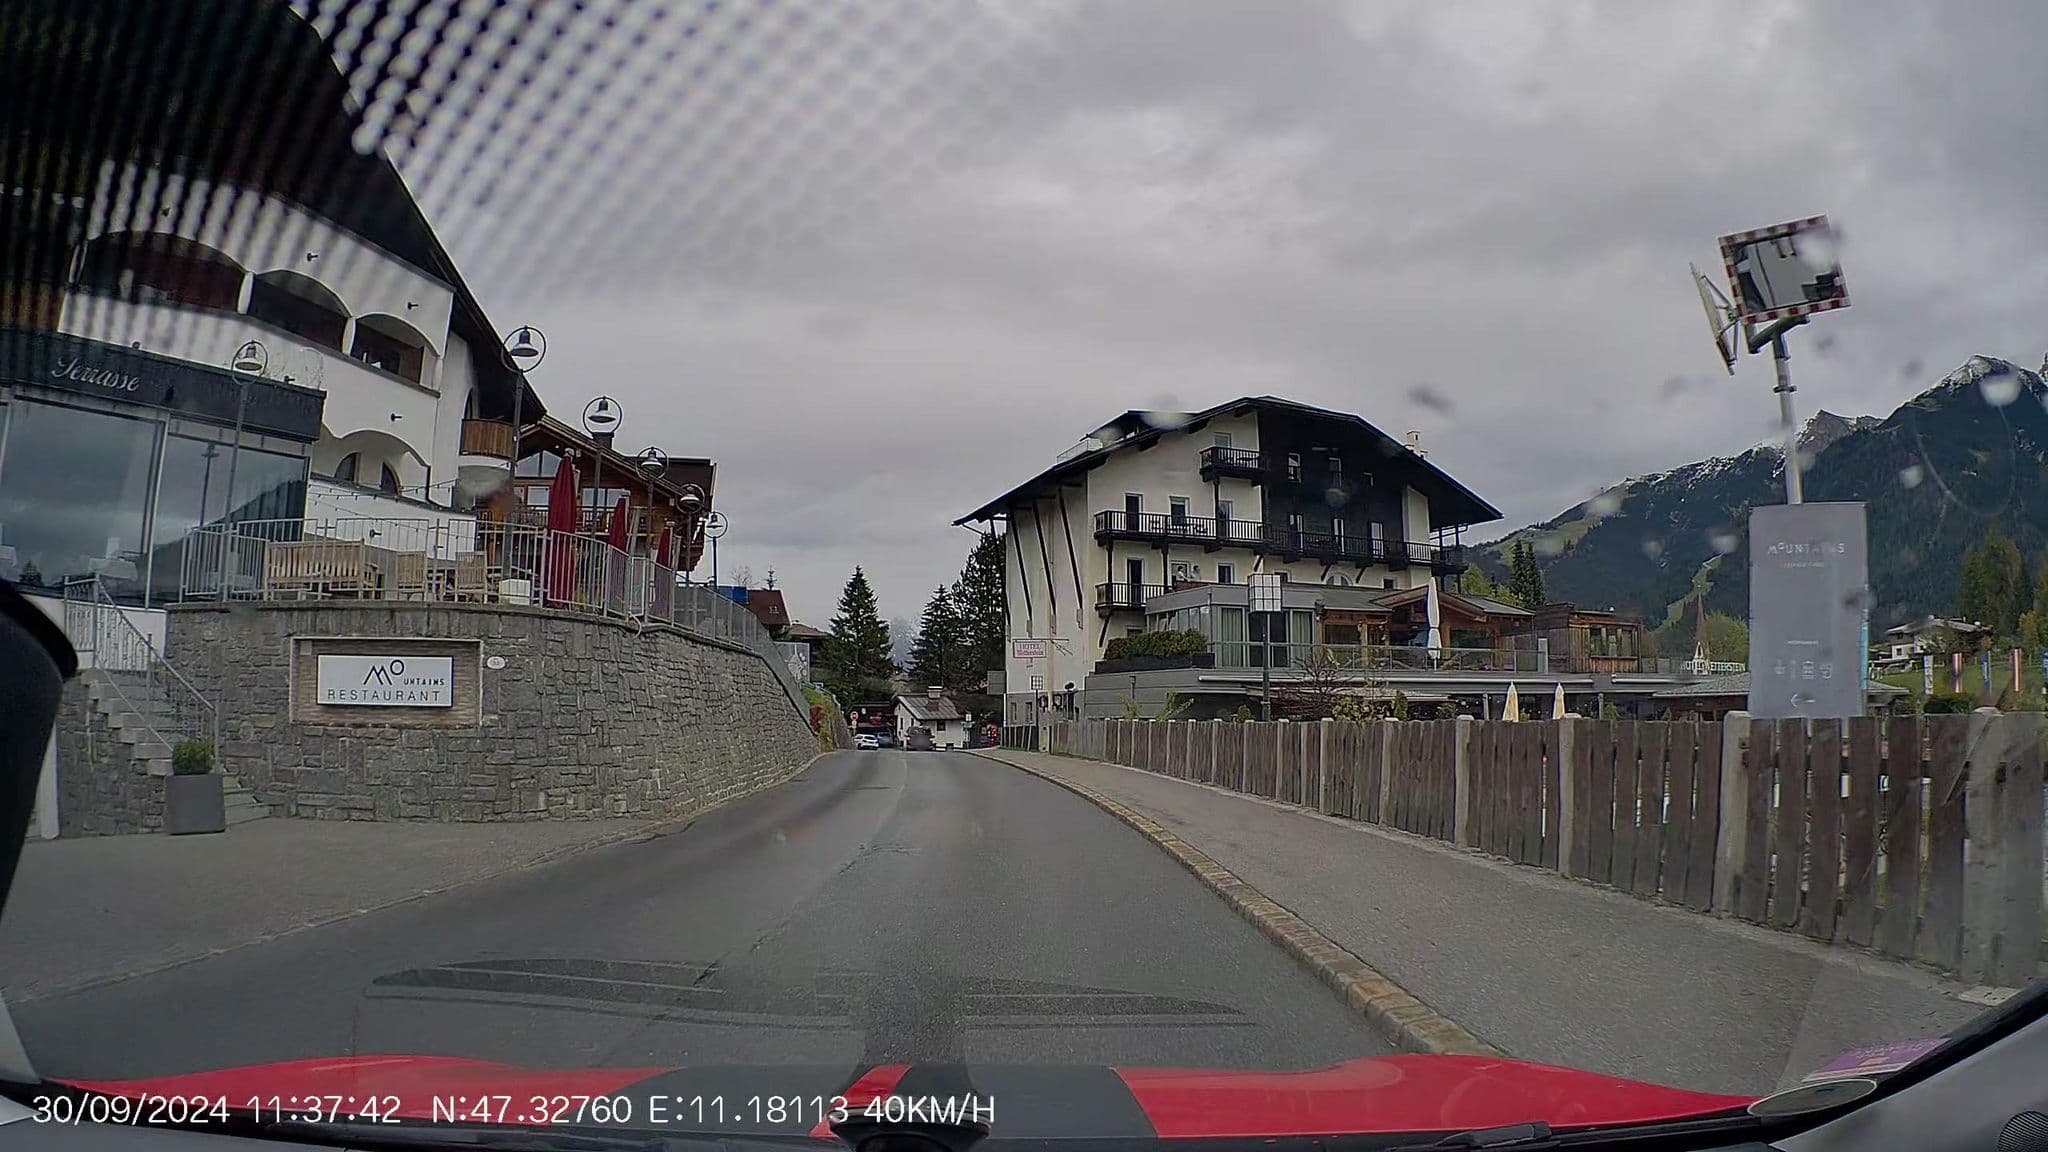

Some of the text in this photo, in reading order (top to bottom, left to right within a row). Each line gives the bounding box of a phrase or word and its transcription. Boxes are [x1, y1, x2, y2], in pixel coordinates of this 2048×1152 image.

[51, 357, 140, 392] Terrasse
[1767, 542, 1845, 554] MOUNTS
[327, 688, 440, 701] RESTAURANT
